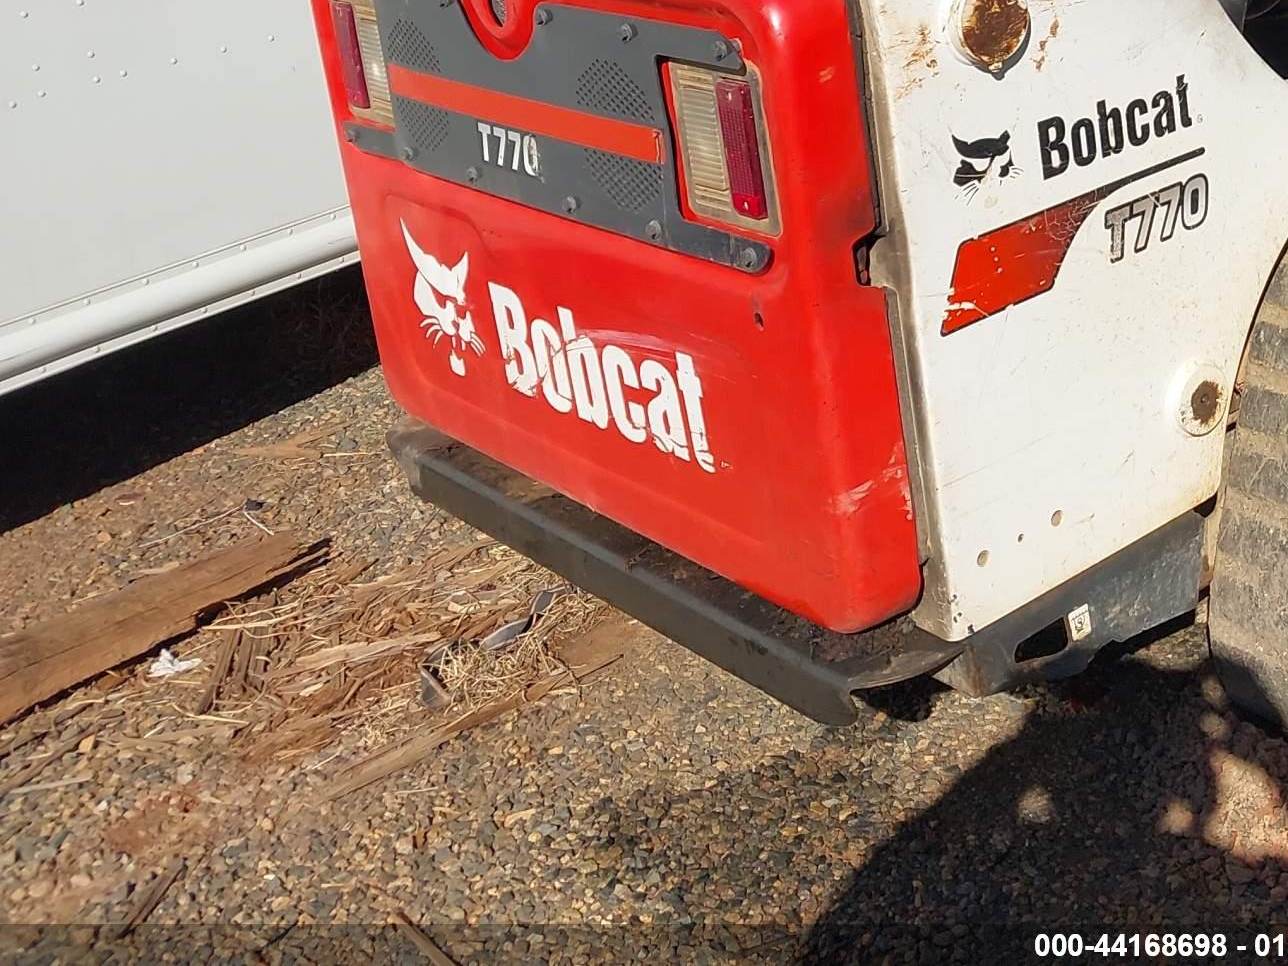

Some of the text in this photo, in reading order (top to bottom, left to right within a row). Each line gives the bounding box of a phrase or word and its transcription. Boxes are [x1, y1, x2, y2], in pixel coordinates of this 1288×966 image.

[477, 122, 539, 176] T770
[1037, 74, 1193, 180] Bobcat
[1104, 173, 1209, 263] T770
[487, 282, 716, 473] Bobcat
